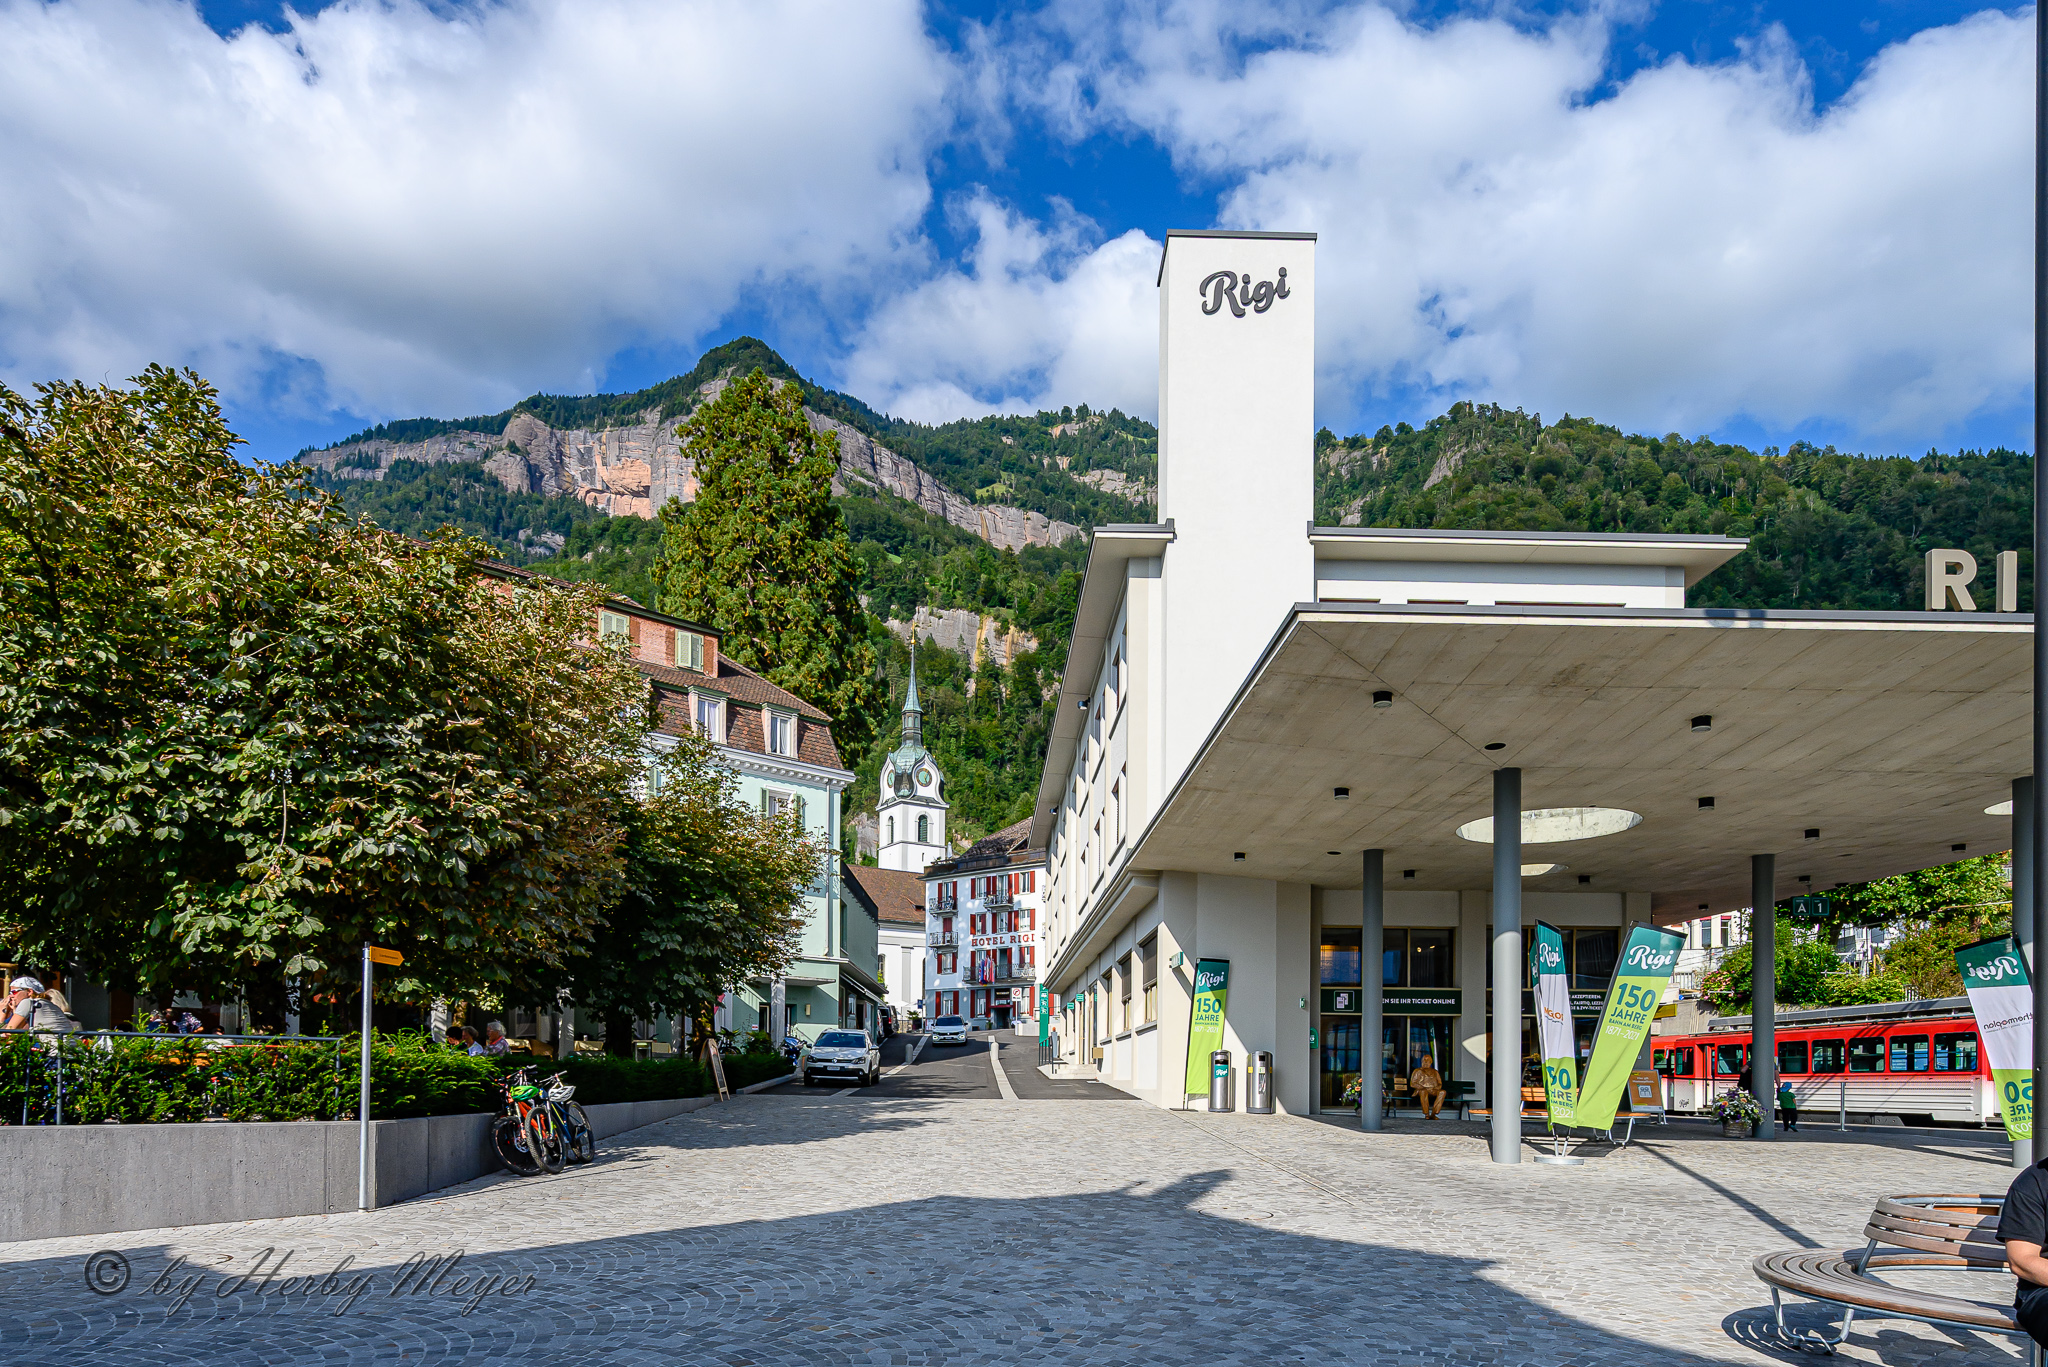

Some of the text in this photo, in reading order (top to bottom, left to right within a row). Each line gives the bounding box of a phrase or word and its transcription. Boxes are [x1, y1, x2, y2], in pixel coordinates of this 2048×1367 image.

[1199, 266, 1291, 318] Rigi
[1797, 903, 1806, 912] A
[971, 934, 1035, 947] HOTEL RIGI
[1540, 943, 1561, 967] Rigi
[1628, 945, 1674, 970] Rigi
[1198, 972, 1224, 987] Rigi
[1196, 998, 1221, 1013] 150
[1617, 983, 1656, 1012] 150
[1609, 1018, 1623, 1026] BAHN
[1611, 1007, 1647, 1024] JAHRE
